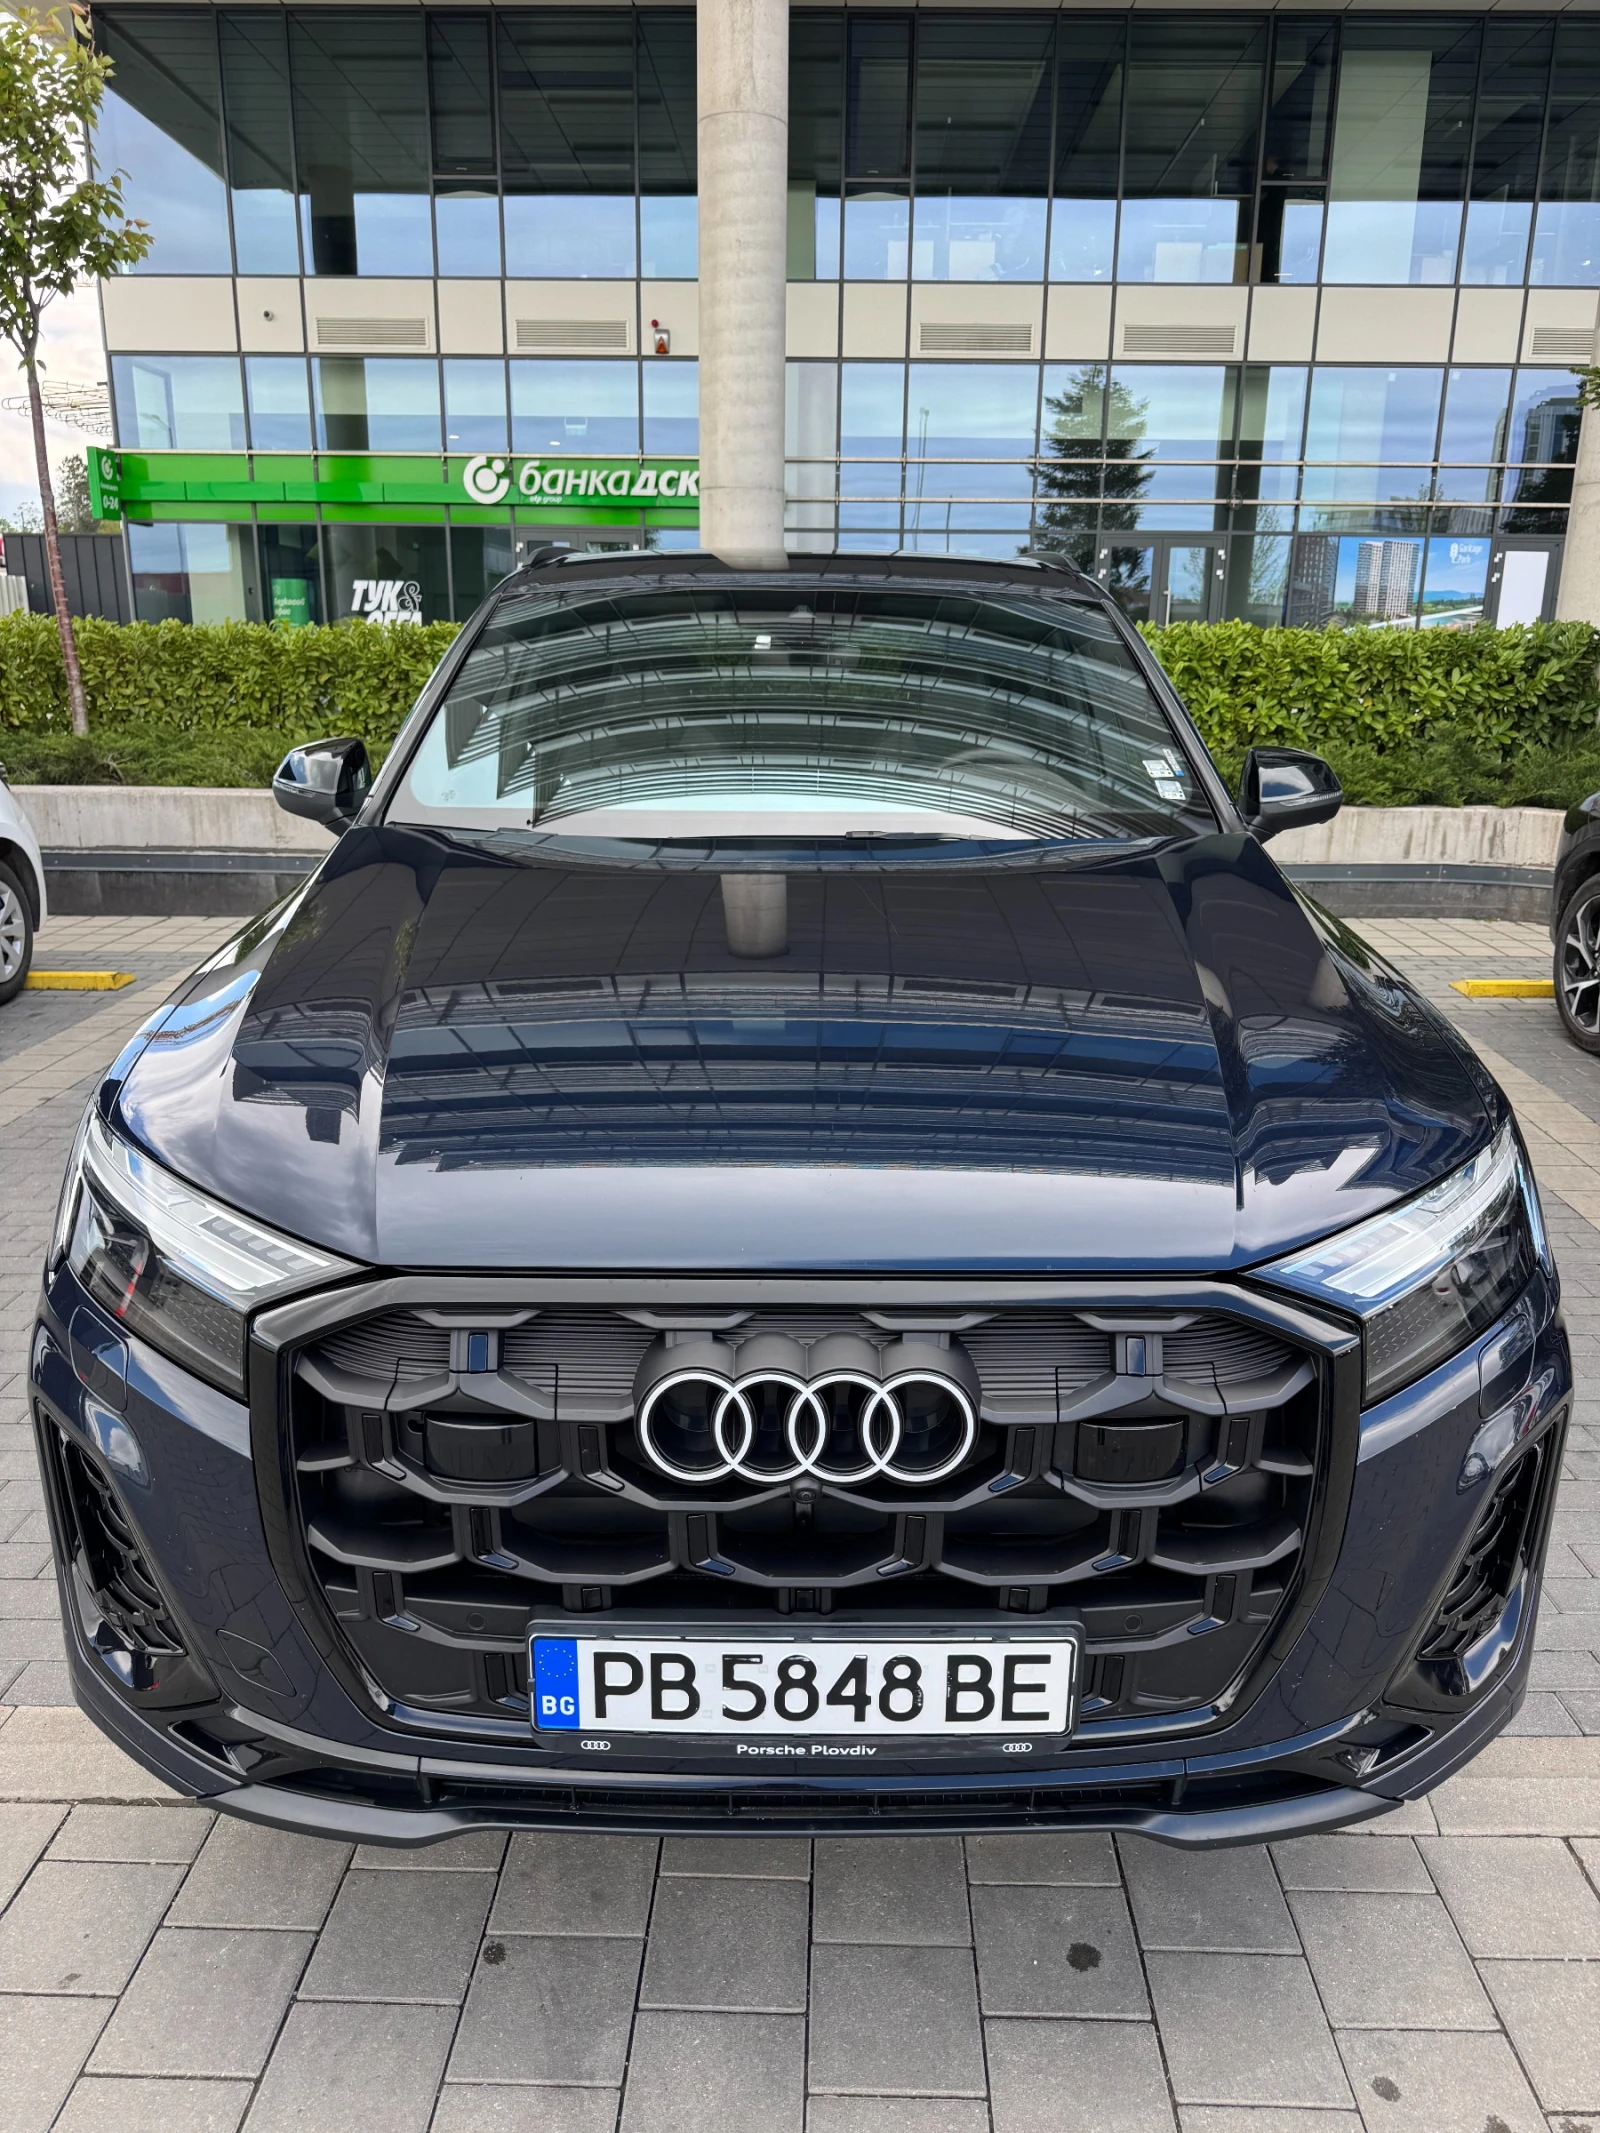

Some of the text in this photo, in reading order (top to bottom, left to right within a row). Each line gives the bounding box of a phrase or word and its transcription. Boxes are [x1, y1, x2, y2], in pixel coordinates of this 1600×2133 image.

[103, 494, 119, 510] 0-24
[529, 495, 563, 504] otp group
[541, 1652, 1051, 1722] BG PB 5848 BE
[737, 1744, 877, 1756] Porsche Plovdiv
